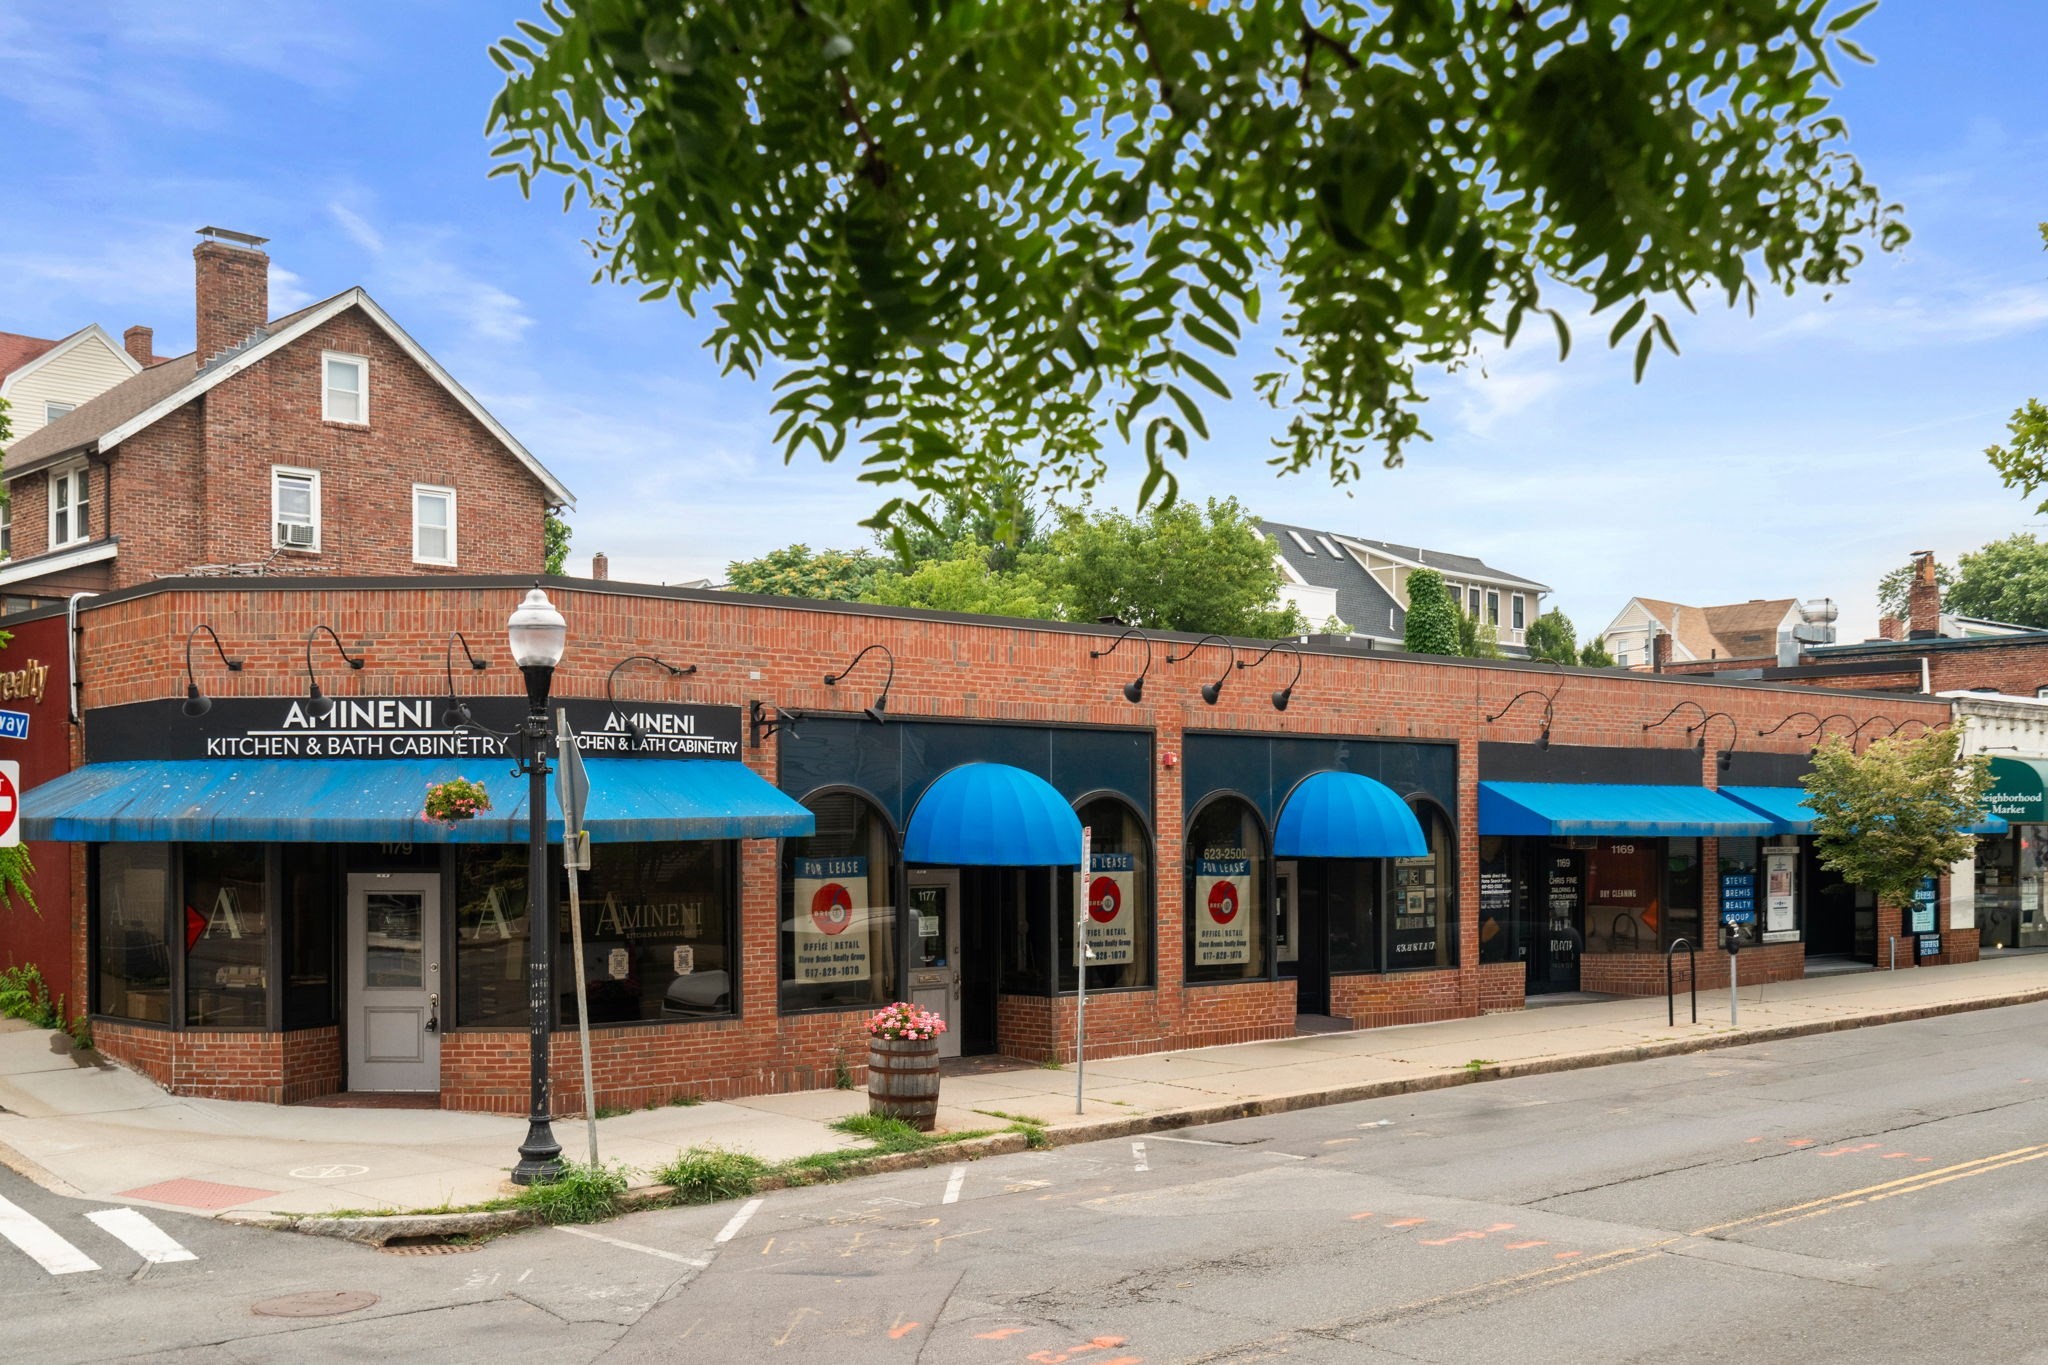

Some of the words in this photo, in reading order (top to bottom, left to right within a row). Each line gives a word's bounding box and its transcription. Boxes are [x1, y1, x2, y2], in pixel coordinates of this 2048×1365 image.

[207, 737, 298, 756] KITCHEN
[306, 737, 323, 755] &
[328, 736, 383, 755] BATH
[389, 736, 509, 755] CABINETRY
[618, 737, 629, 751] &
[669, 739, 738, 754] CABINETRY
[1992, 804, 2025, 814] Market
[1204, 848, 1247, 859] 623-2500
[1611, 845, 1635, 854] 1169
[805, 862, 822, 875] FOR
[829, 861, 859, 874] LEASE
[1101, 857, 1128, 868] LEASE
[1203, 862, 1217, 873] FOR
[1220, 862, 1245, 873] LEASE
[1726, 877, 1747, 885] STEVE
[918, 890, 936, 902] 1177
[1612, 889, 1637, 898] CLEANING
[1726, 888, 1750, 897] BREMIS
[1726, 901, 1750, 909] REALTY
[1726, 913, 1749, 921] GROUP
[803, 940, 828, 951] OFFICE
[834, 940, 860, 950] RETAIL
